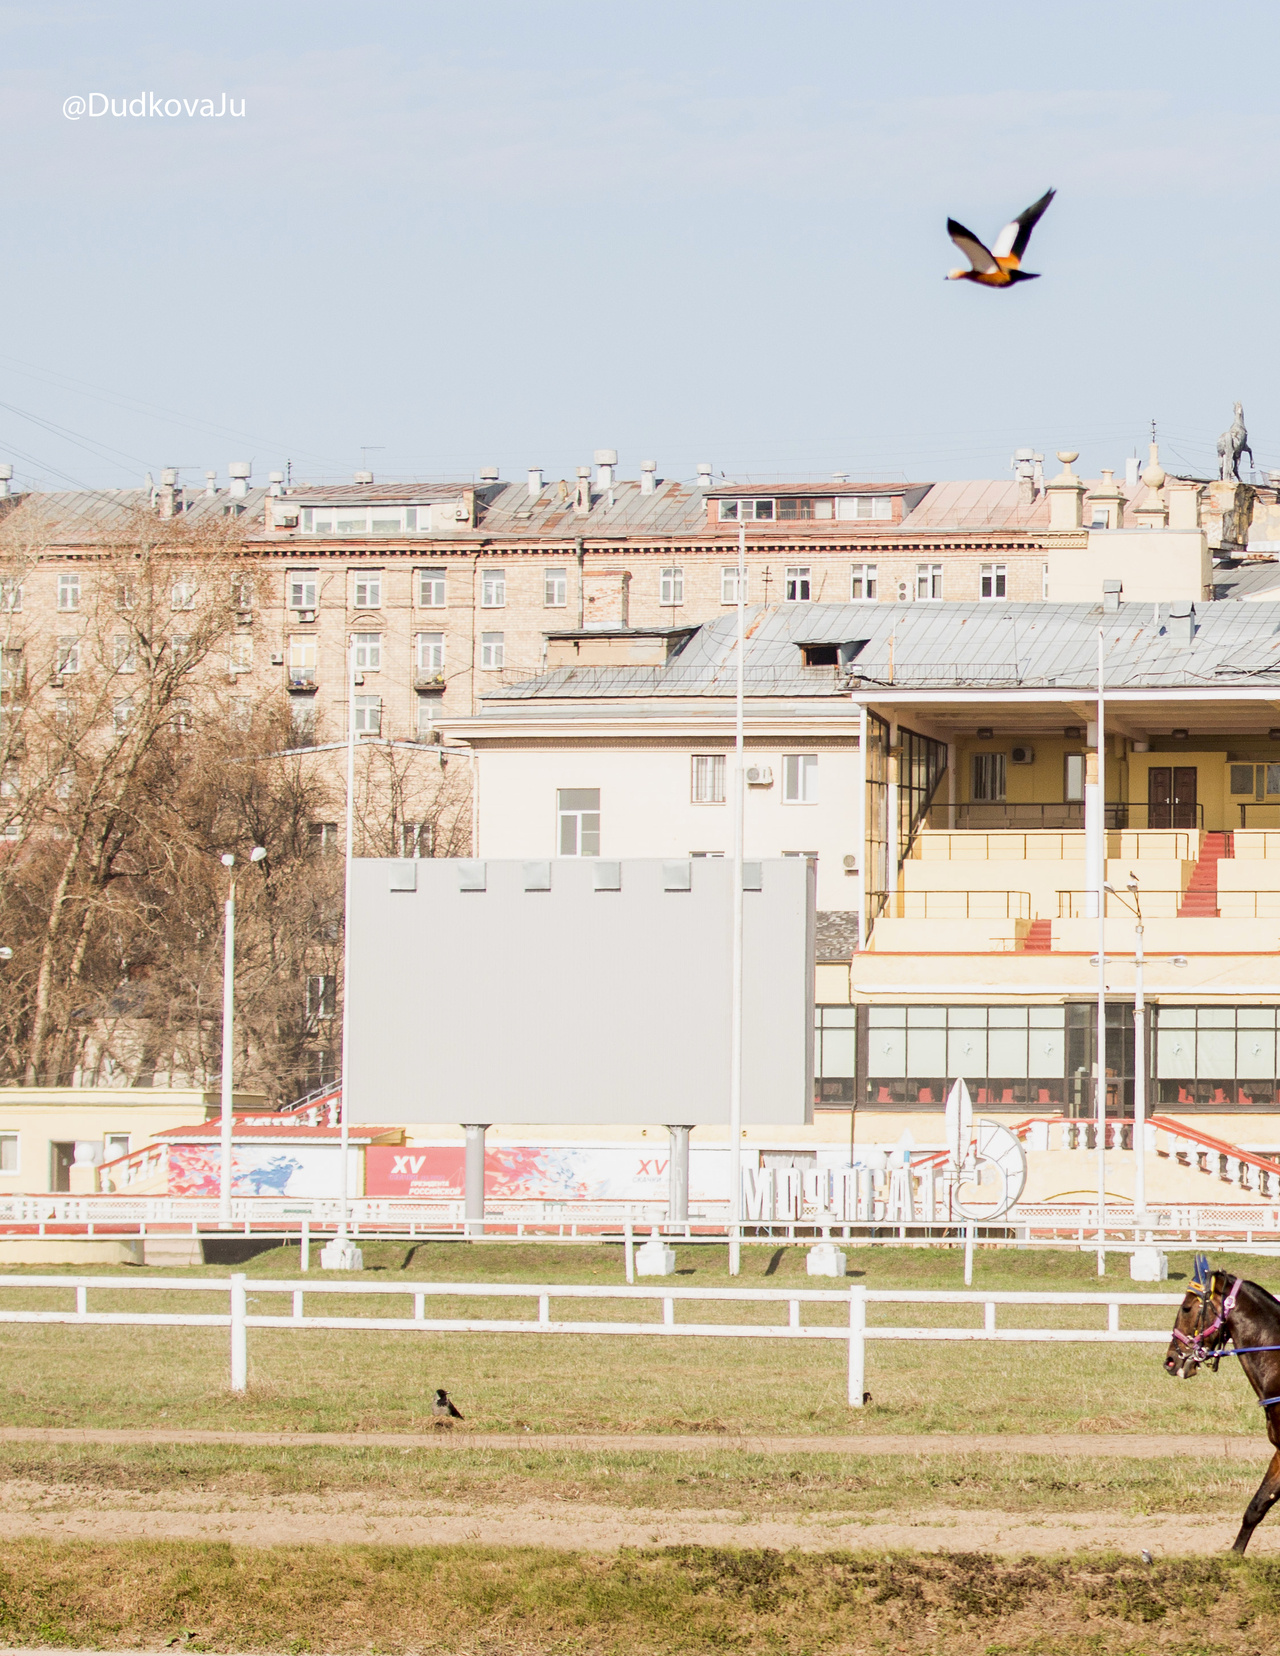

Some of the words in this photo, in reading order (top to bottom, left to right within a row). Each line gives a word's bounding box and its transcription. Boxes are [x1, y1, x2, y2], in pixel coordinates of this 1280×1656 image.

[390, 1155, 427, 1174] XV
[636, 1159, 670, 1175] XV
[408, 1187, 461, 1196] РОССИЙСКОЙ
